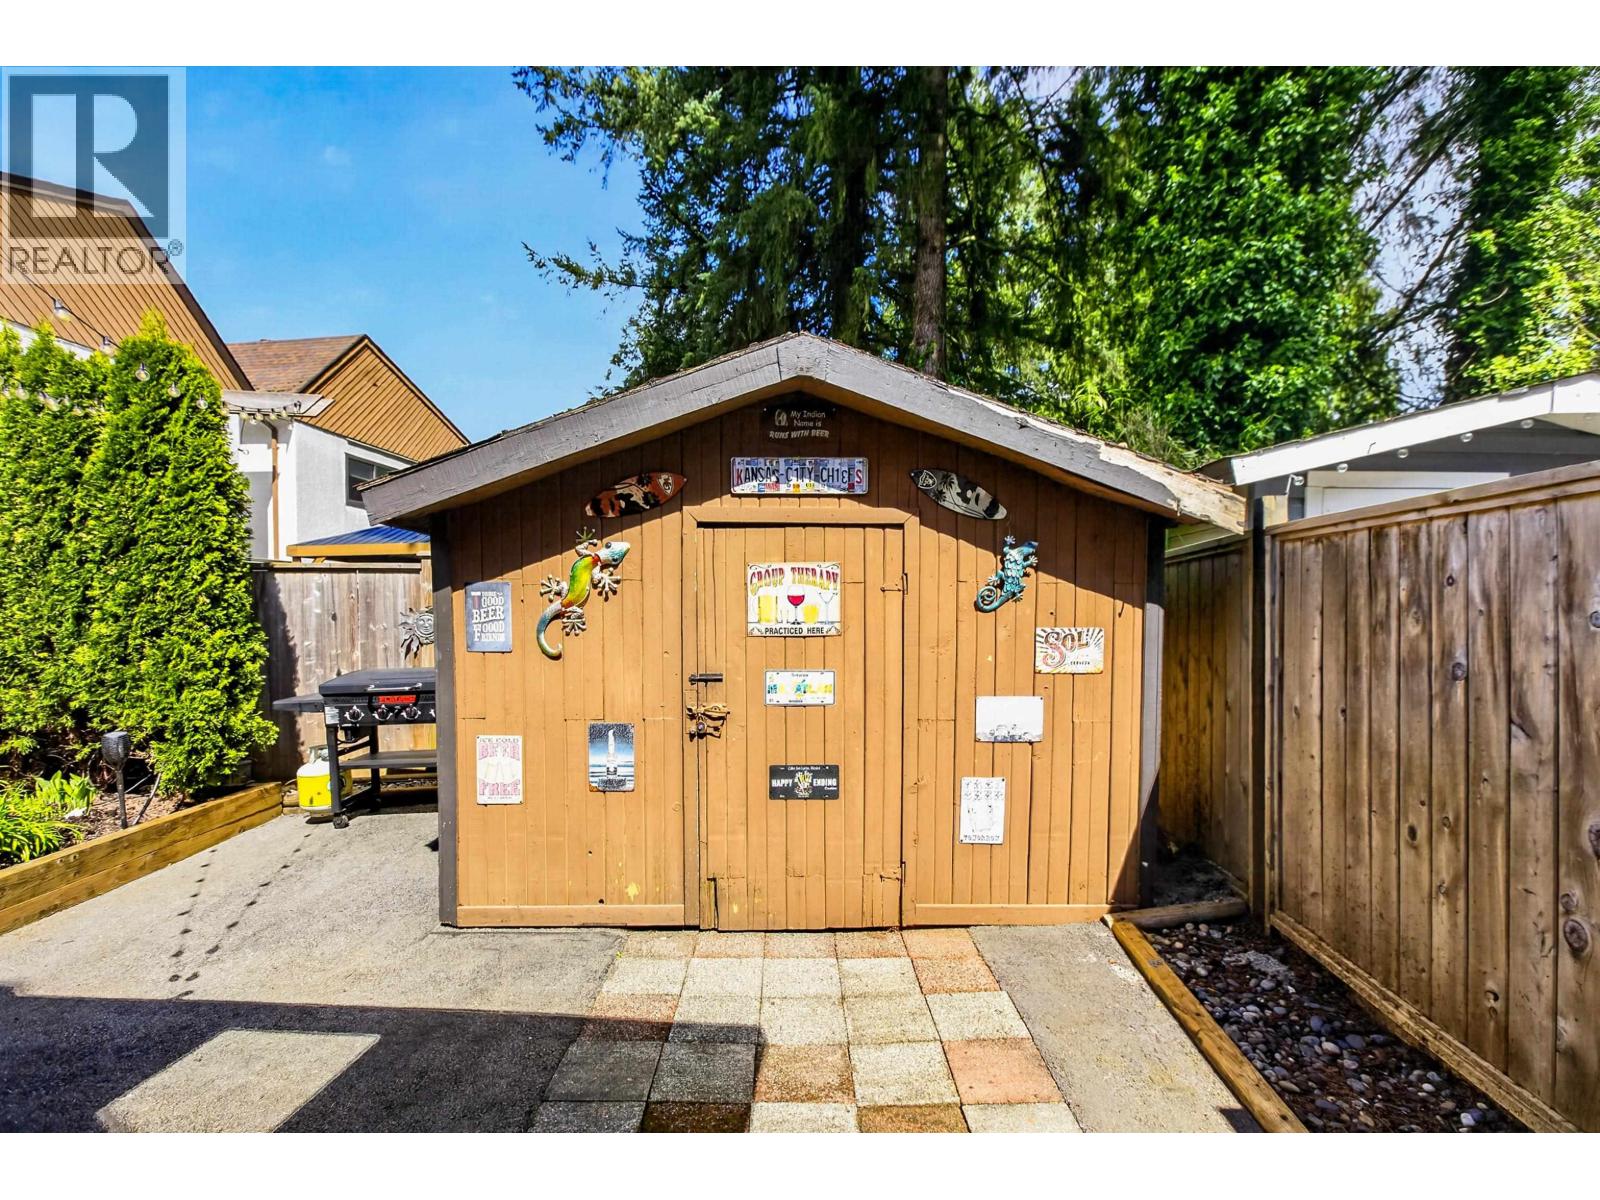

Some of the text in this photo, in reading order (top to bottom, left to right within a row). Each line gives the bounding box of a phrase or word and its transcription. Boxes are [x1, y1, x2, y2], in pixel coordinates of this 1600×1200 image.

[802, 410, 826, 418] Indian
[794, 419, 822, 427] Name is
[769, 429, 830, 439] RUNS WITH BEER
[749, 566, 839, 596] GROUP THERAPY
[481, 596, 505, 608] GOOD
[472, 606, 505, 623] BEER
[482, 621, 505, 633] GOOD
[764, 626, 824, 635] PRACTICED HERE
[771, 778, 837, 788] HAPPY ENDING
